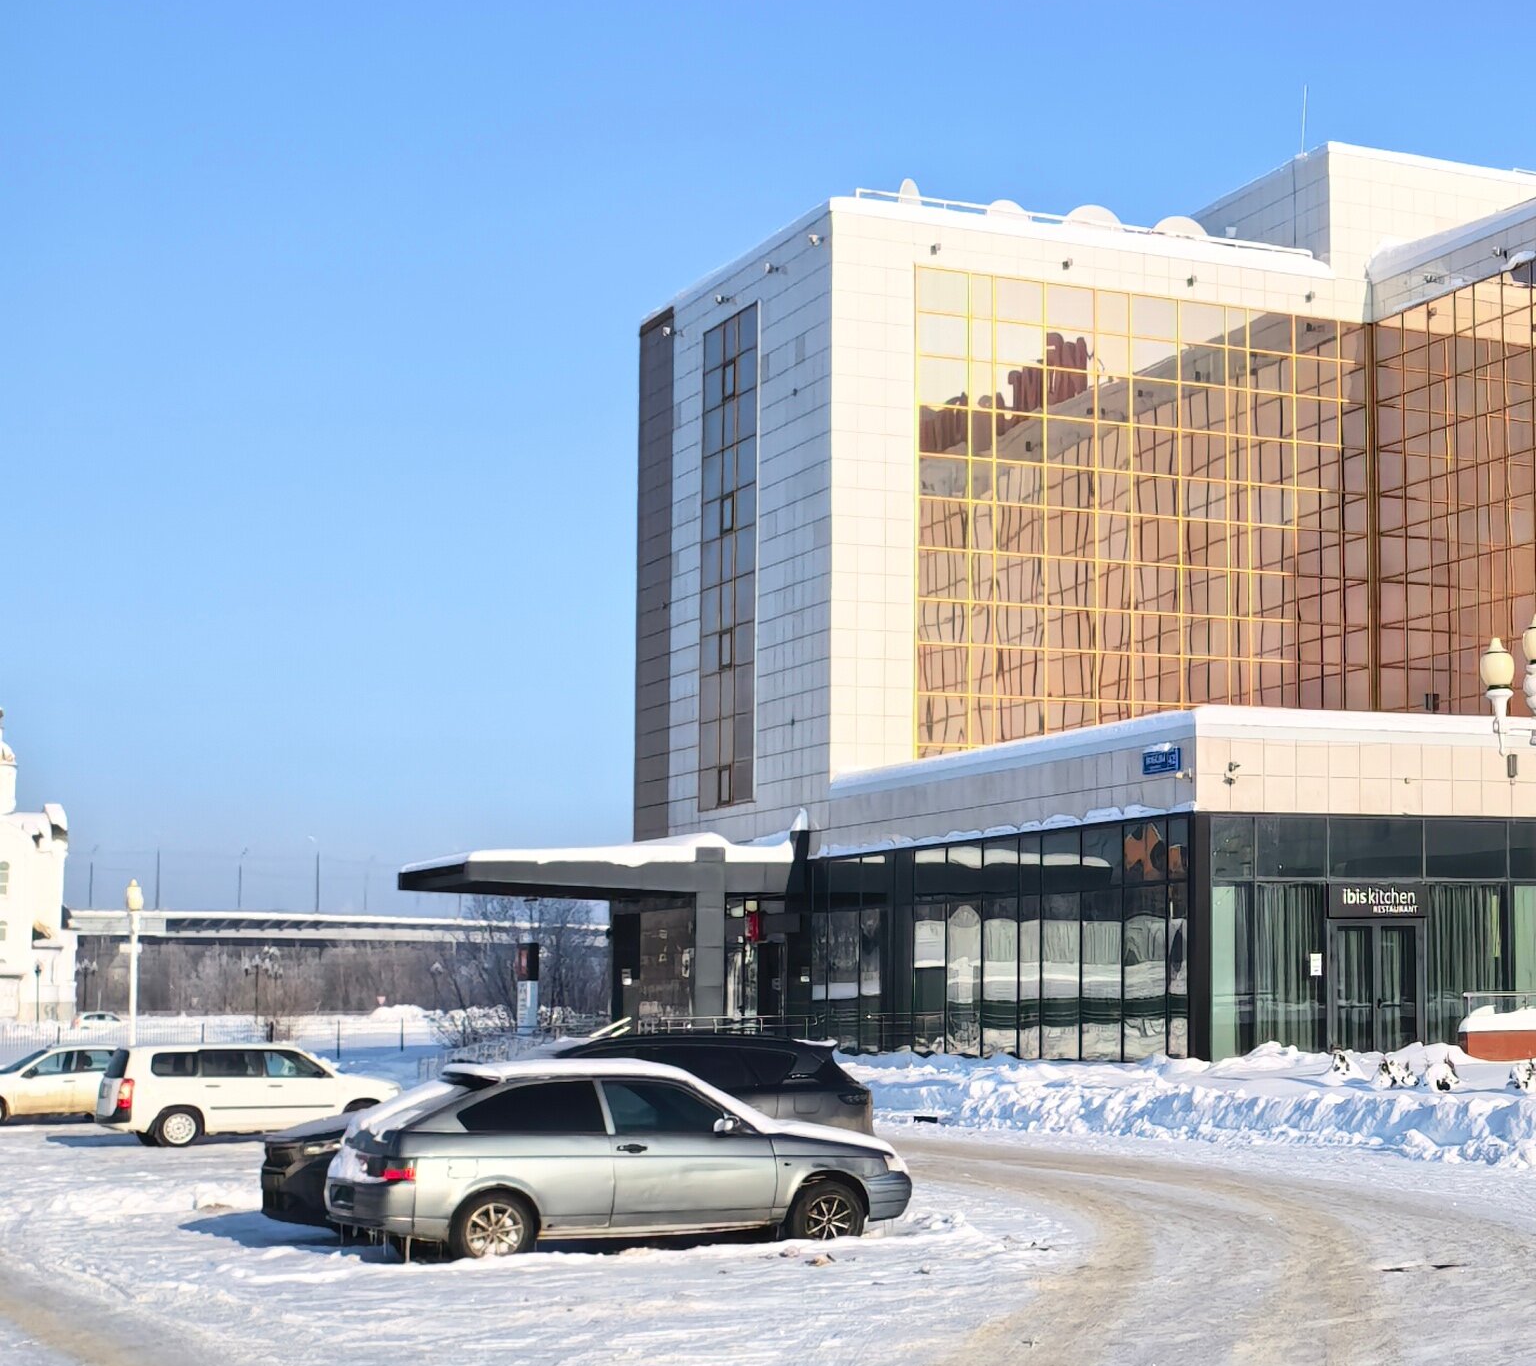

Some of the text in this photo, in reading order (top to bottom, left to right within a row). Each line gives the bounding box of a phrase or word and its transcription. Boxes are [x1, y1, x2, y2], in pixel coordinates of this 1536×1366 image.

[1343, 887, 1416, 905] ibis kitchen
[1373, 905, 1418, 914] RESTAURANT
